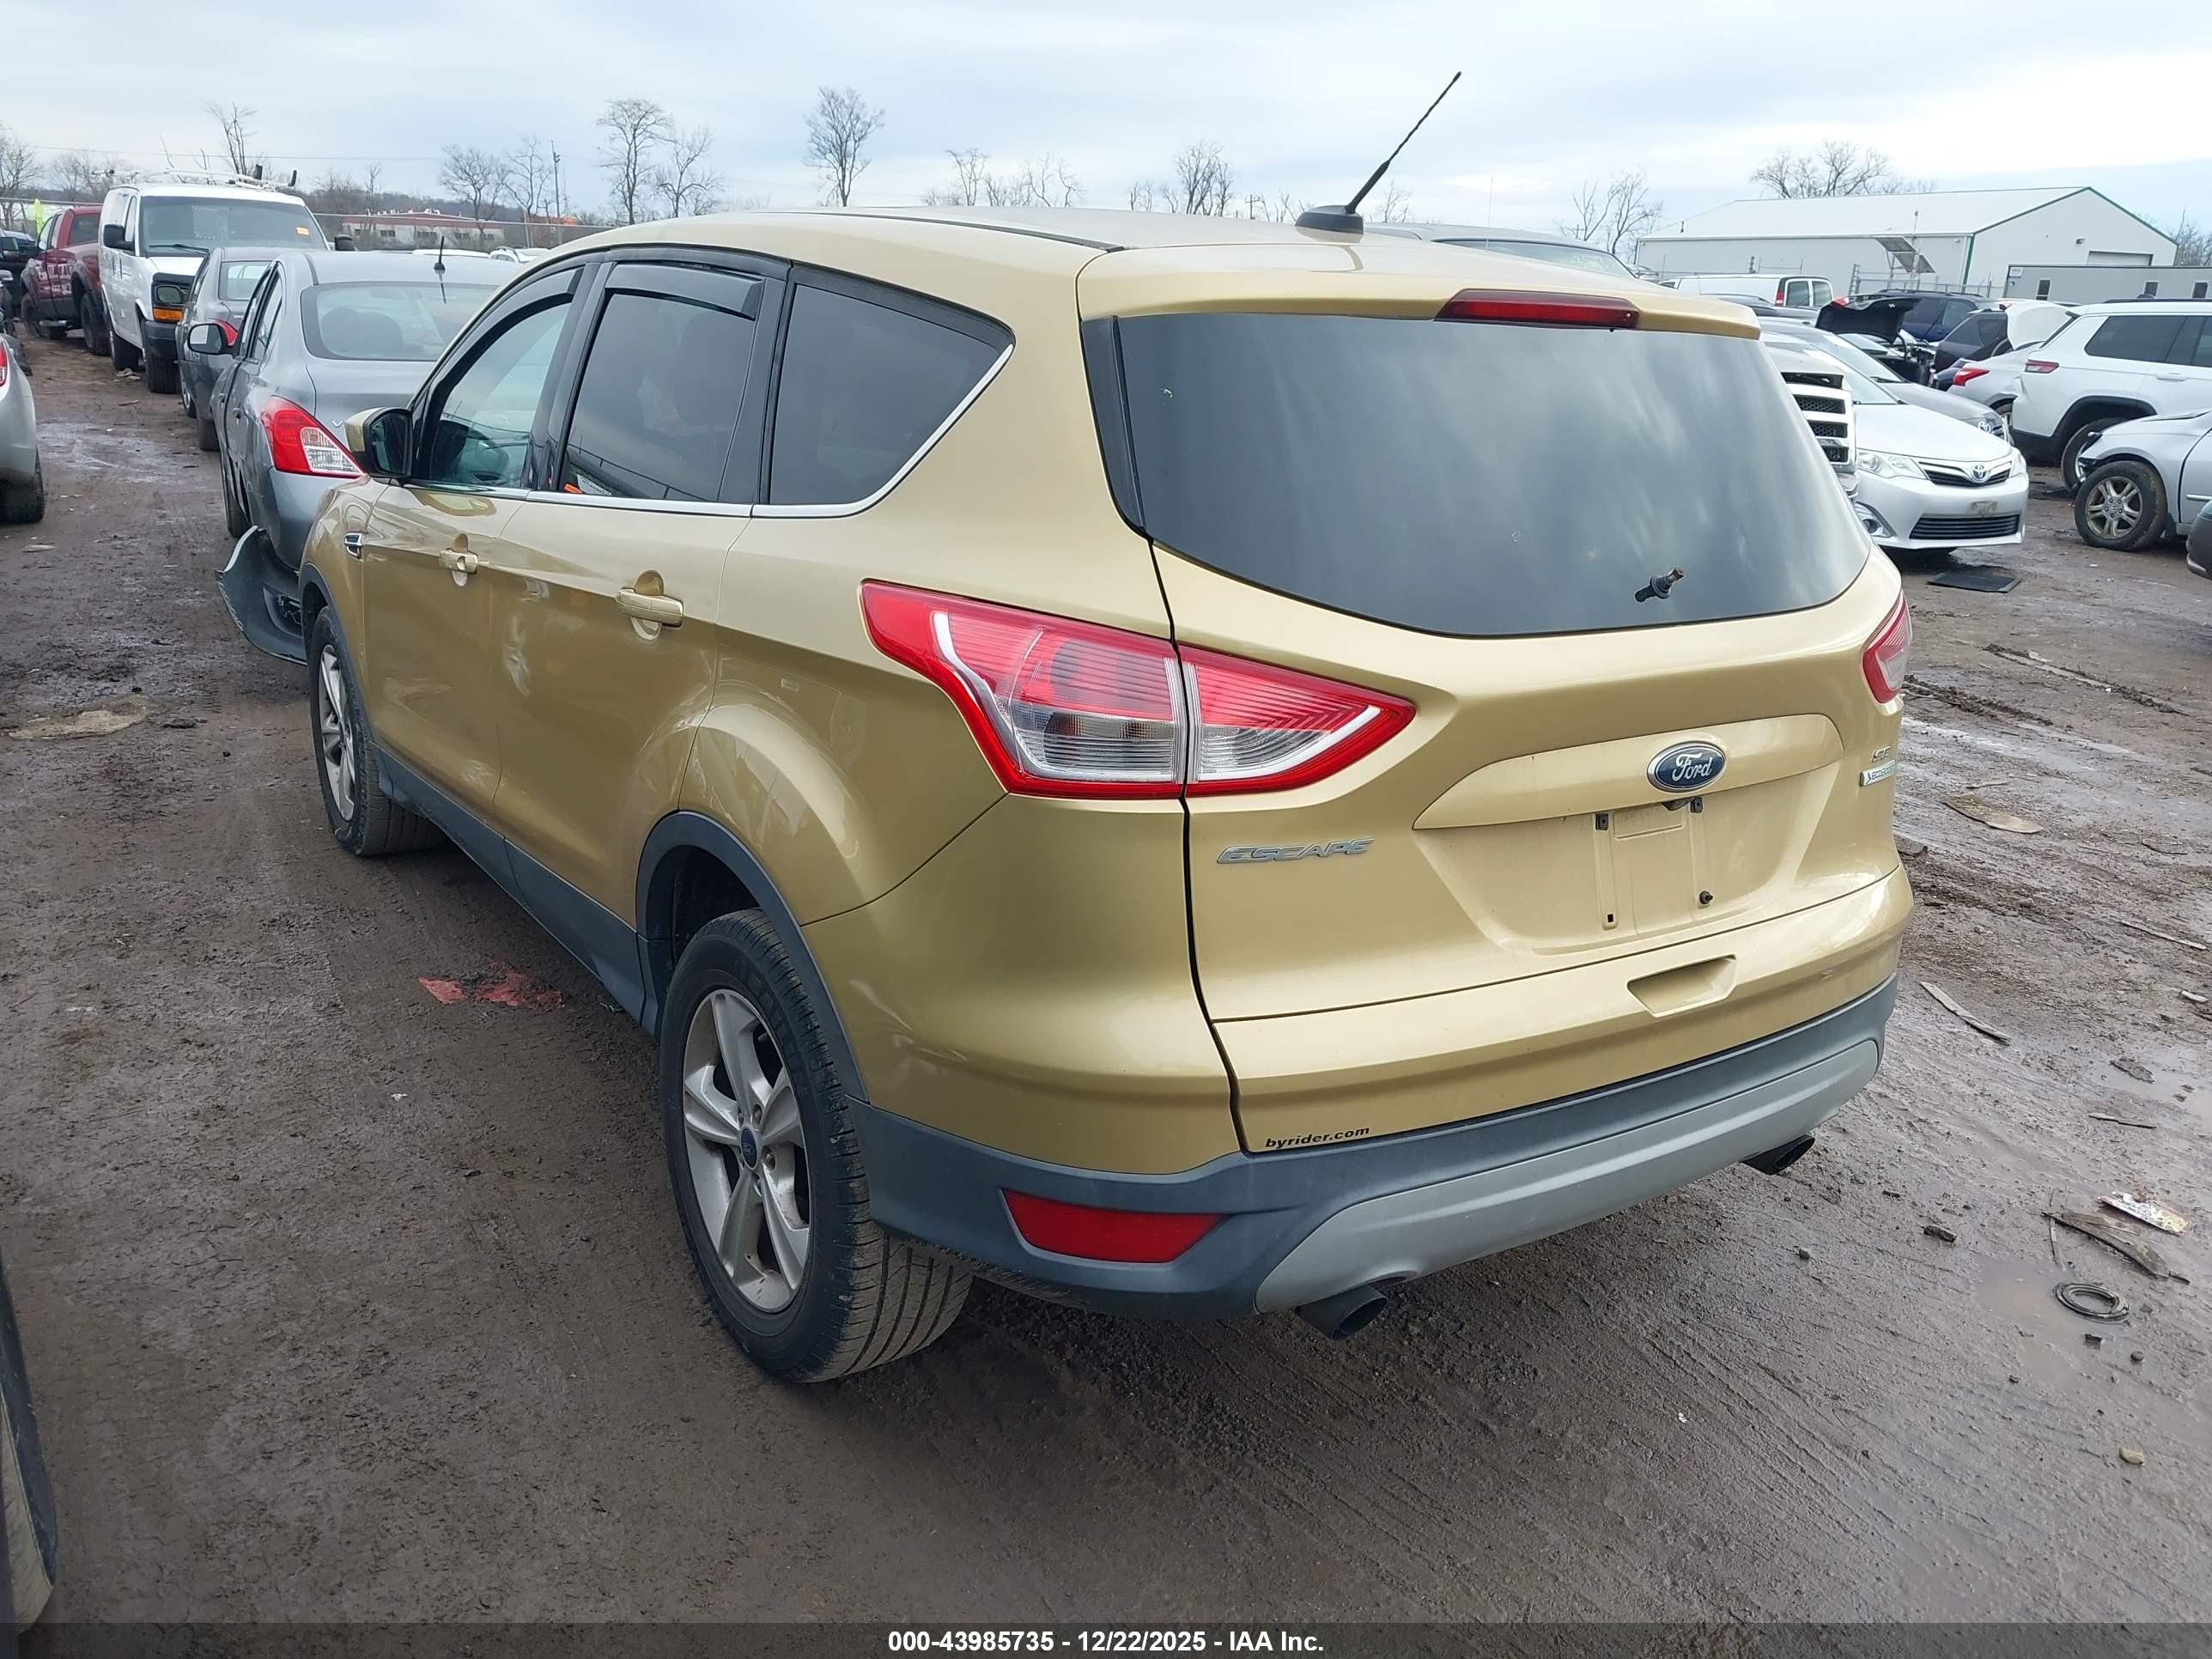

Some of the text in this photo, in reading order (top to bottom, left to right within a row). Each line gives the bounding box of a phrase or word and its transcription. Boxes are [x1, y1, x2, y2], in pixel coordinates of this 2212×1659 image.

[1672, 752, 1714, 781] Ford
[1217, 837, 1375, 865] ESCAPE
[1264, 1127, 1370, 1150] byrider.com
